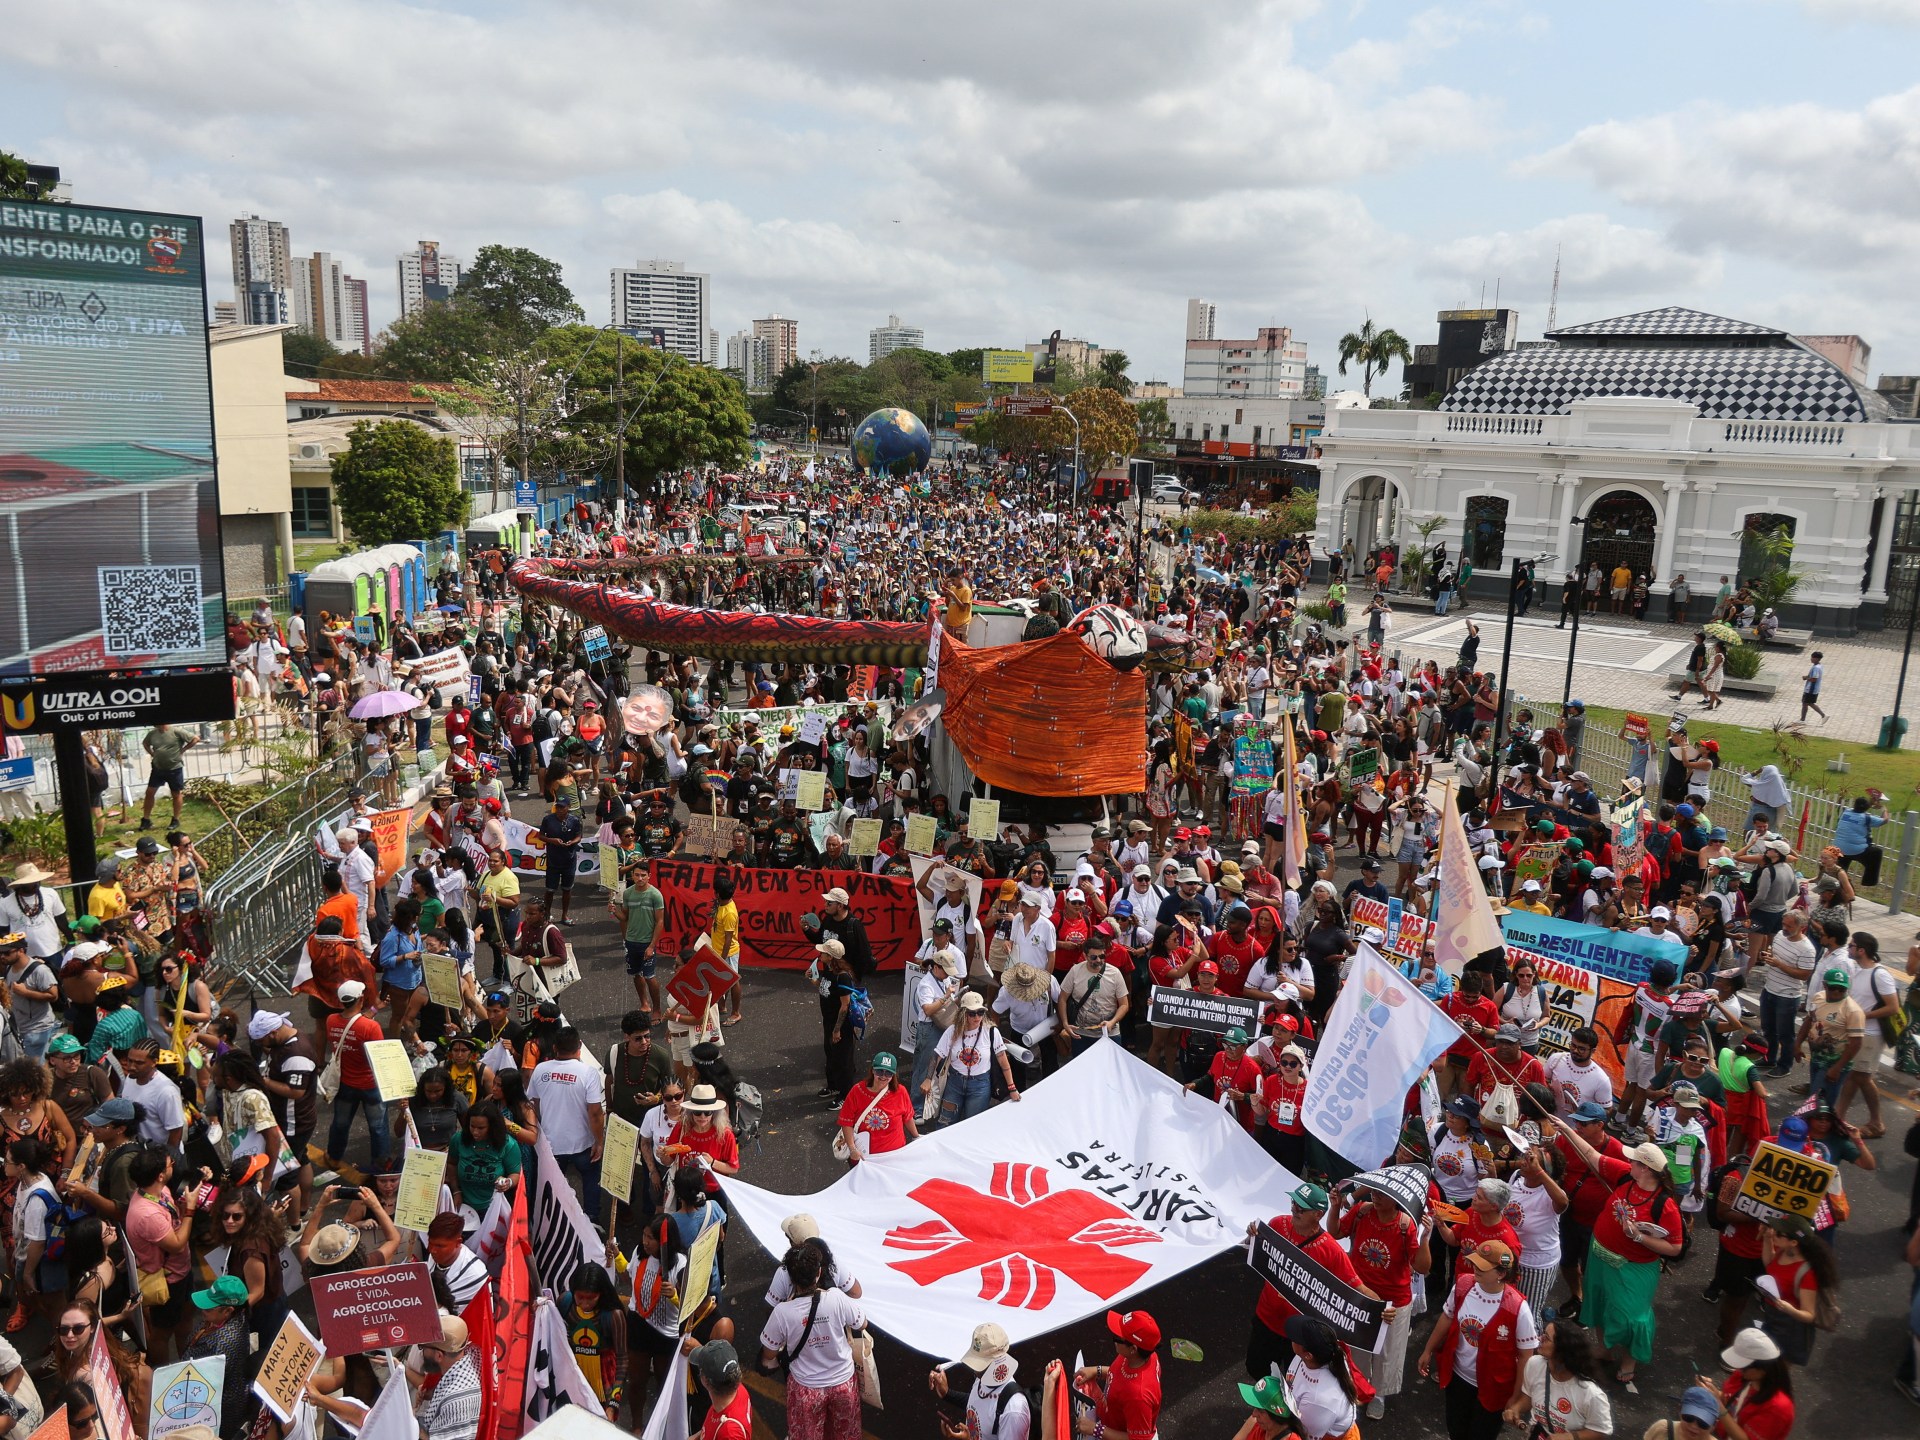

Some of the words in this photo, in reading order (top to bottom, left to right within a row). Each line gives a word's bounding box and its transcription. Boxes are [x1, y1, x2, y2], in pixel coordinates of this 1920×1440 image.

[68, 214, 125, 239] PARA
[130, 222, 144, 240] O
[94, 316, 119, 333] do
[124, 317, 187, 336] TJPA
[6, 328, 111, 348] Ambiente
[583, 626, 604, 642] AGRO
[589, 645, 612, 661] FOME
[42, 691, 106, 710] ULTRA
[110, 687, 160, 706] OOH
[61, 713, 84, 723] Out
[88, 711, 100, 721] of
[103, 709, 136, 720] Home
[1350, 771, 1376, 787] GOLPE
[663, 896, 709, 933] MAS
[1507, 929, 1537, 944] MAIS
[1538, 932, 1655, 976] RESILIENTES
[1156, 993, 1184, 1006] QUANDO
[1185, 998, 1190, 1006] A
[1190, 998, 1226, 1013] AMAZÔNIA
[1227, 1003, 1255, 1018] QUEIMA,
[1163, 1006, 1168, 1014] O
[1169, 1006, 1199, 1020] PLANETA
[1199, 1010, 1226, 1024] INTEIRO
[1227, 1016, 1246, 1027] ARDE
[289, 1073, 303, 1087] 21
[551, 1072, 577, 1083] FNEEI
[1410, 1168, 1429, 1193] HABIT
[1752, 1152, 1829, 1194] AGRO
[1388, 1179, 1414, 1202] OUTRA
[327, 1271, 417, 1293] AGROECOLOGIA
[1261, 1239, 1285, 1268] CLIMA
[1285, 1258, 1291, 1270] E
[1291, 1261, 1330, 1300] ECOLOGIA
[1332, 1292, 1346, 1312] EM
[1343, 1301, 1371, 1325] PROL
[356, 1290, 363, 1301] É
[365, 1288, 394, 1300] VIDA.
[1267, 1259, 1276, 1276] DA
[1278, 1267, 1295, 1291] VIDA
[1295, 1284, 1308, 1302] EM
[1308, 1292, 1355, 1333] HARMONIA
[332, 1296, 422, 1319] AGROECOLOGIA
[363, 1315, 370, 1326] É
[371, 1313, 399, 1324] LUTA.
[263, 1332, 288, 1381] MARLY
[275, 1341, 307, 1398] ANTONIA
[284, 1347, 315, 1408] SEMENTE
[156, 1422, 190, 1434] FLORESTA
